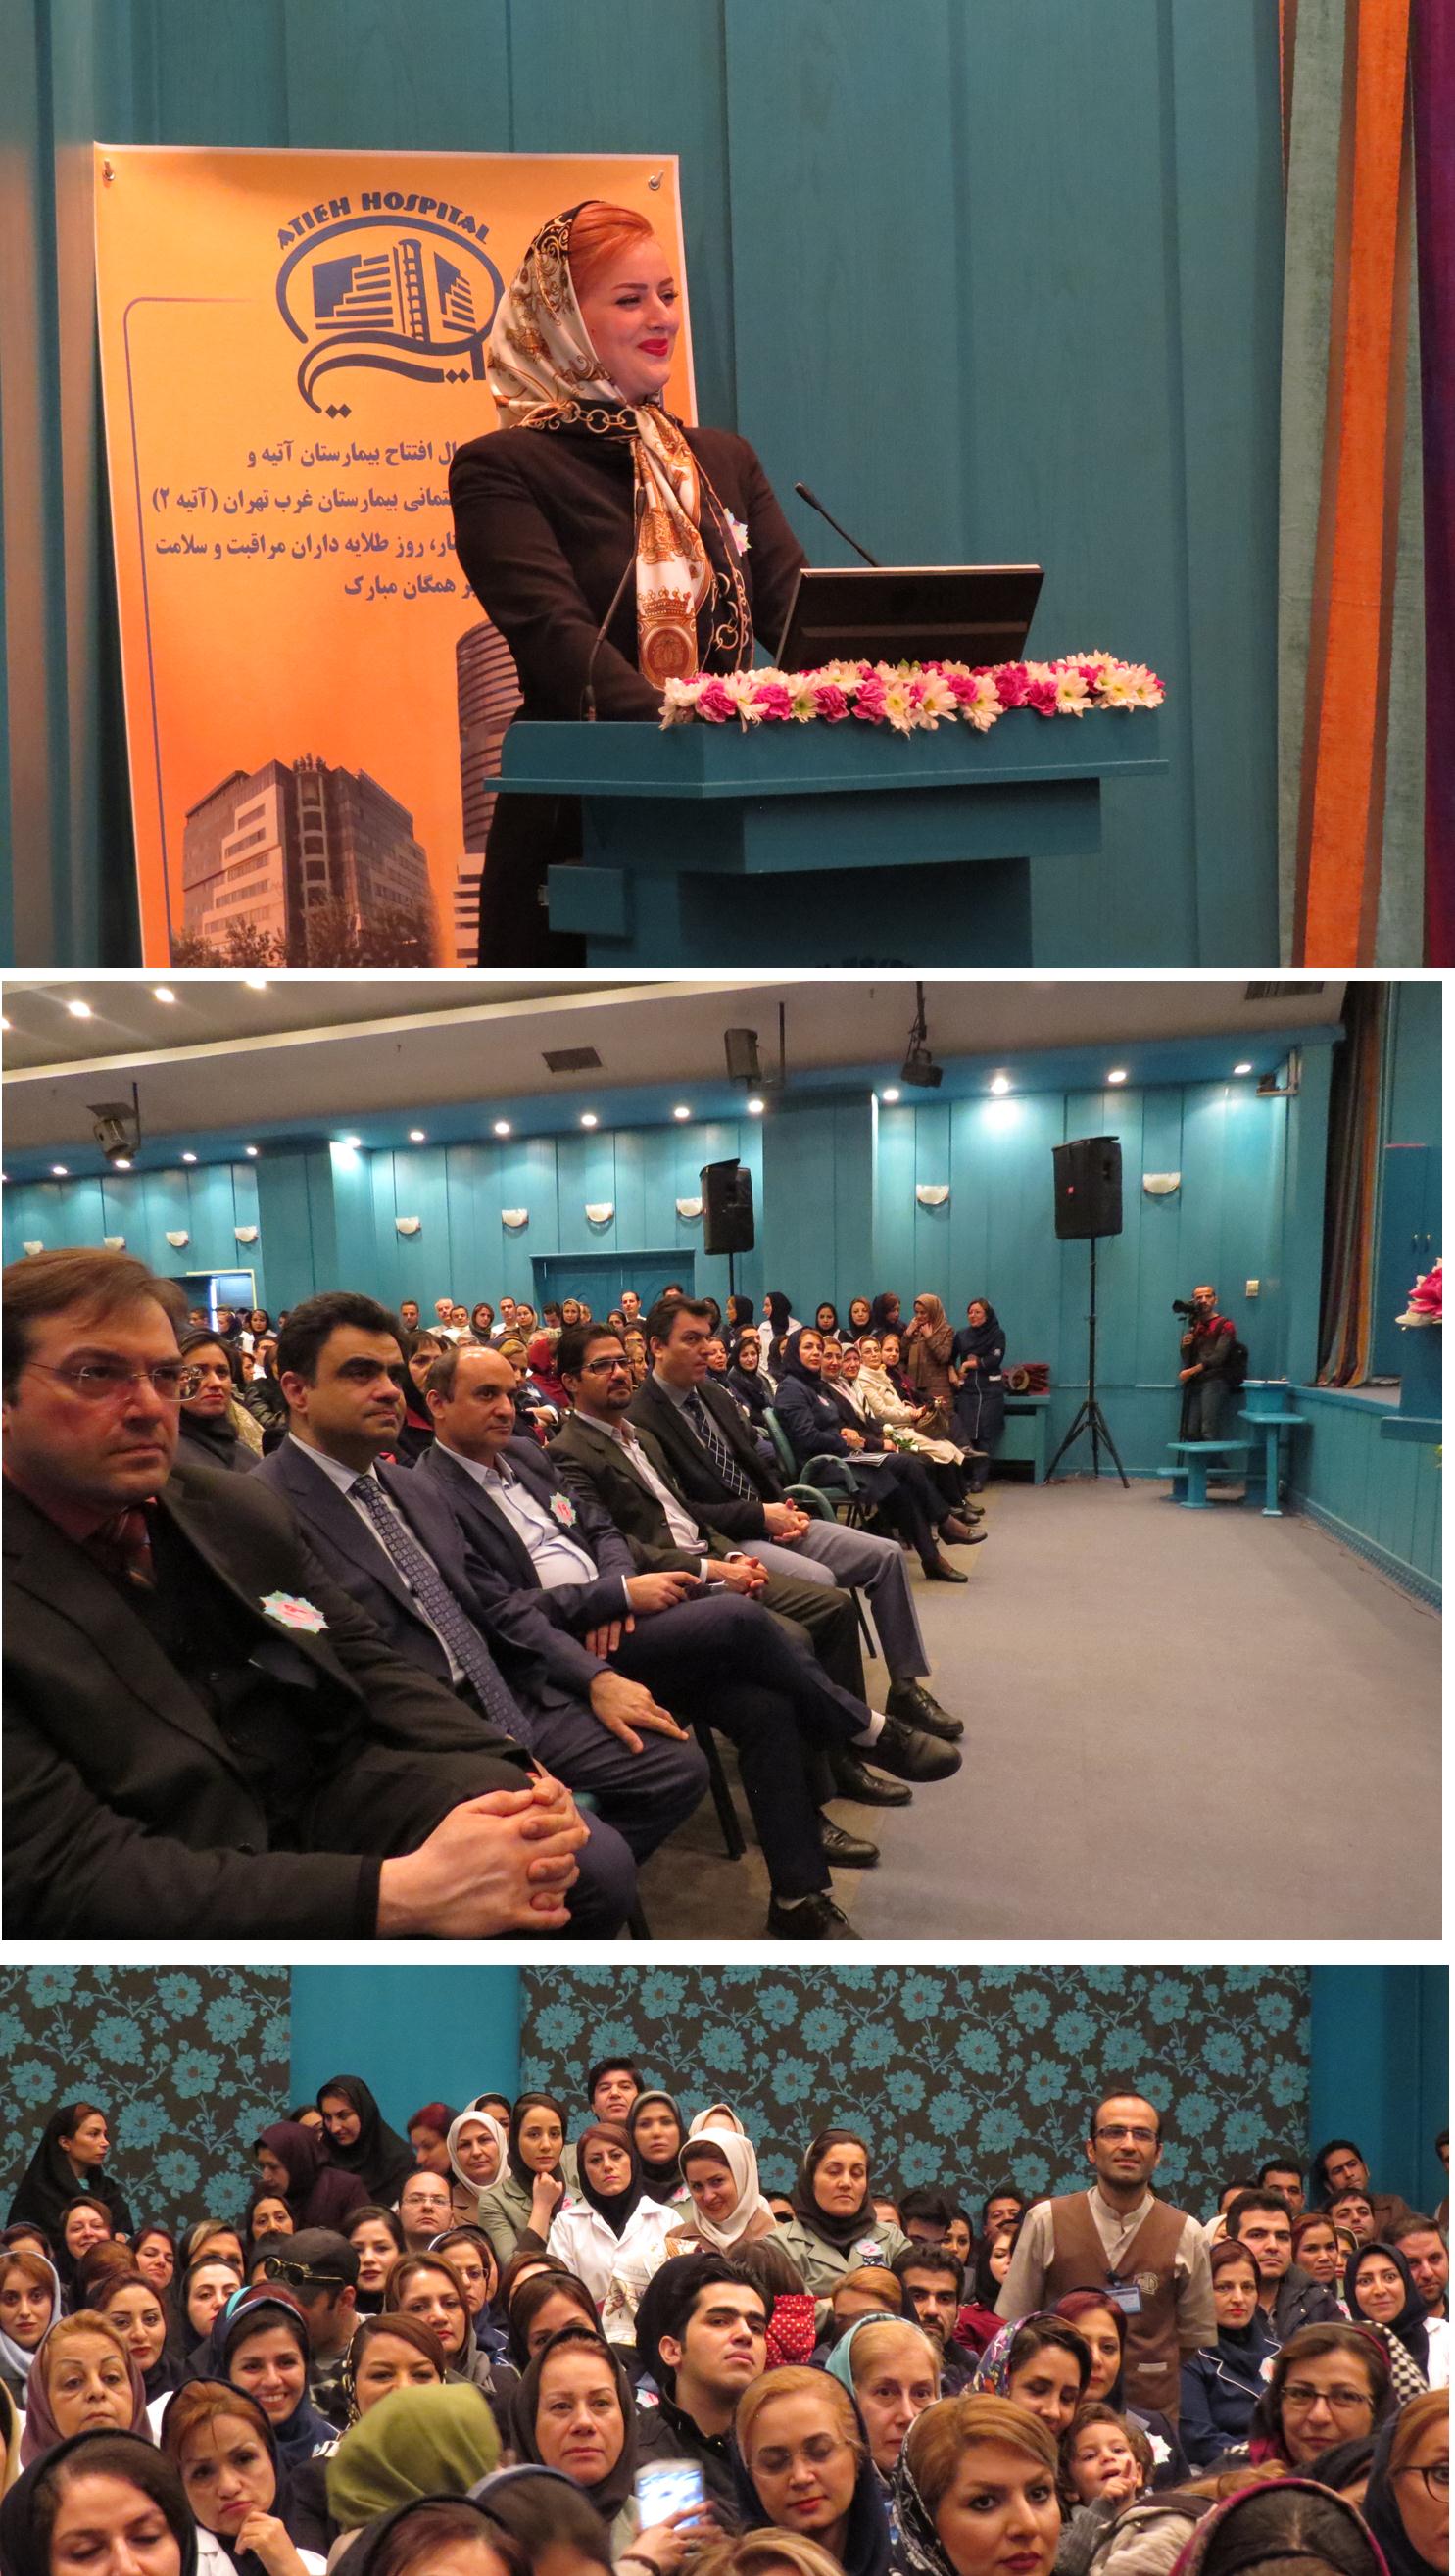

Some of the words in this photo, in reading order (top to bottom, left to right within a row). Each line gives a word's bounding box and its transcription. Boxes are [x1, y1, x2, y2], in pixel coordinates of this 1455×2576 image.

[277, 196, 351, 250] ATIEH
[361, 191, 490, 245] HOSPITAL
[246, 450, 257, 468] و
[261, 439, 294, 466] آتیه
[300, 441, 380, 467] بیمارستان
[385, 440, 433, 466] افتتاح
[223, 489, 269, 514] تهران
[274, 489, 313, 514] غرب
[318, 488, 398, 513] بیمارستان
[155, 533, 208, 555] سلامت
[213, 542, 222, 560] و
[226, 532, 286, 559] مراقبت
[291, 533, 339, 559] داران
[344, 532, 389, 557] طلایه
[395, 536, 424, 558] روز
[344, 574, 398, 601] مبارک
[403, 574, 456, 600] همگان
